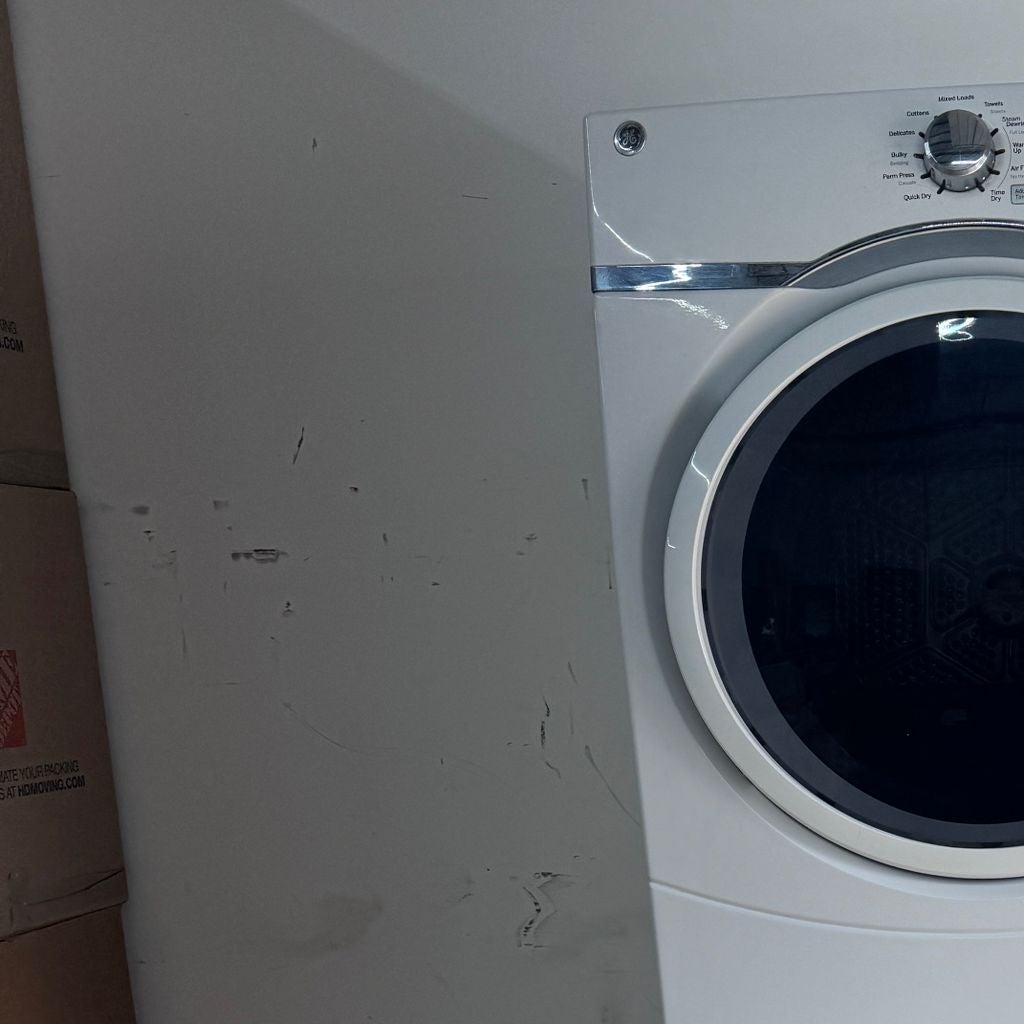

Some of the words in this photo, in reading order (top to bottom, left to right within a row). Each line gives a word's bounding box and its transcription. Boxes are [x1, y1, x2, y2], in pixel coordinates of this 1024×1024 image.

[18, 765, 44, 780] YOUR
[44, 760, 79, 776] PACKING
[6, 786, 16, 800] AT
[18, 775, 86, 796] HDMOVING.COM
